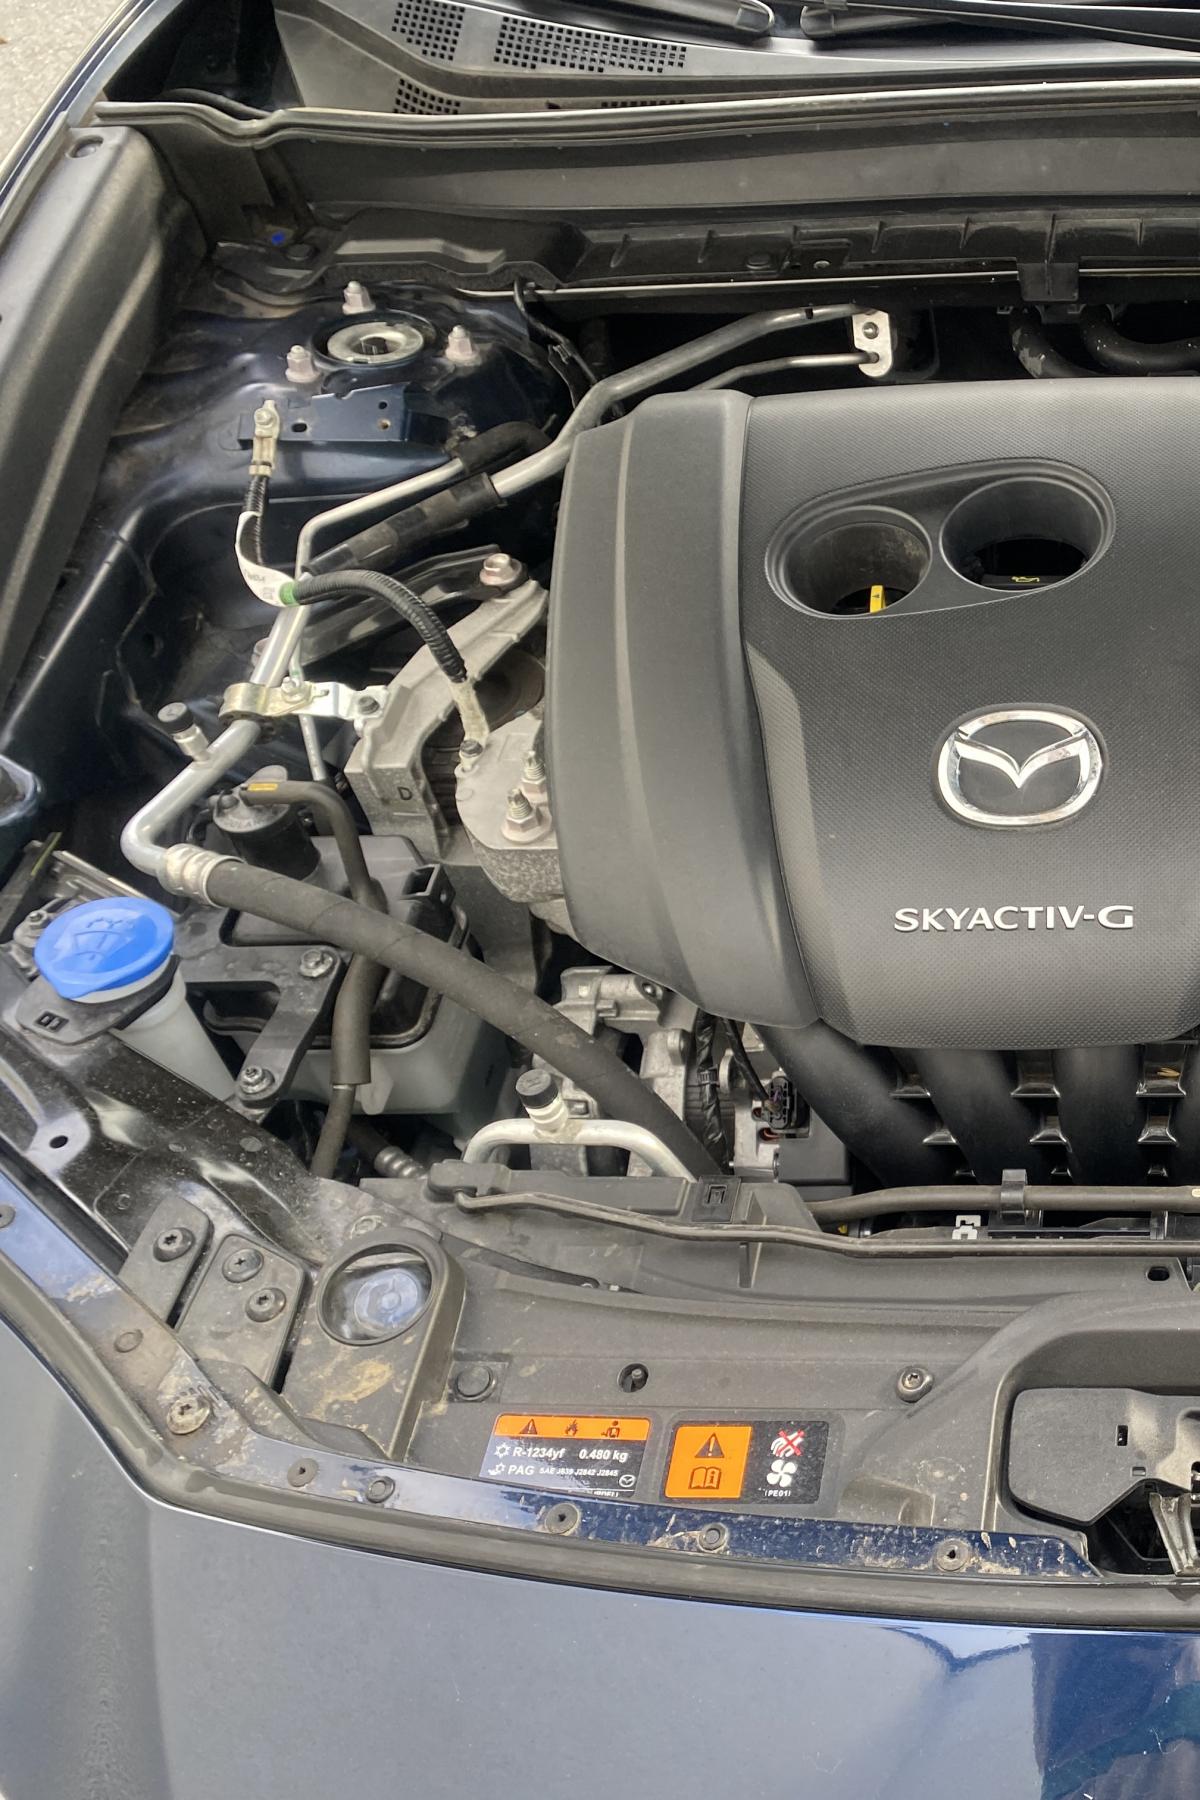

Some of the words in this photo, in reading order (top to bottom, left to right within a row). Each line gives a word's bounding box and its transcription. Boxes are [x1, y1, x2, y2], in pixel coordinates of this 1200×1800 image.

[397, 786, 413, 801] D
[893, 905, 1134, 932] SKYACTIV-G
[512, 1447, 565, 1460] R-1234yf
[578, 1448, 611, 1460] 0.480
[612, 1449, 629, 1463] kg
[507, 1464, 535, 1476] PAG
[539, 1467, 555, 1475] SAE
[764, 1489, 791, 1497] (PE01)
